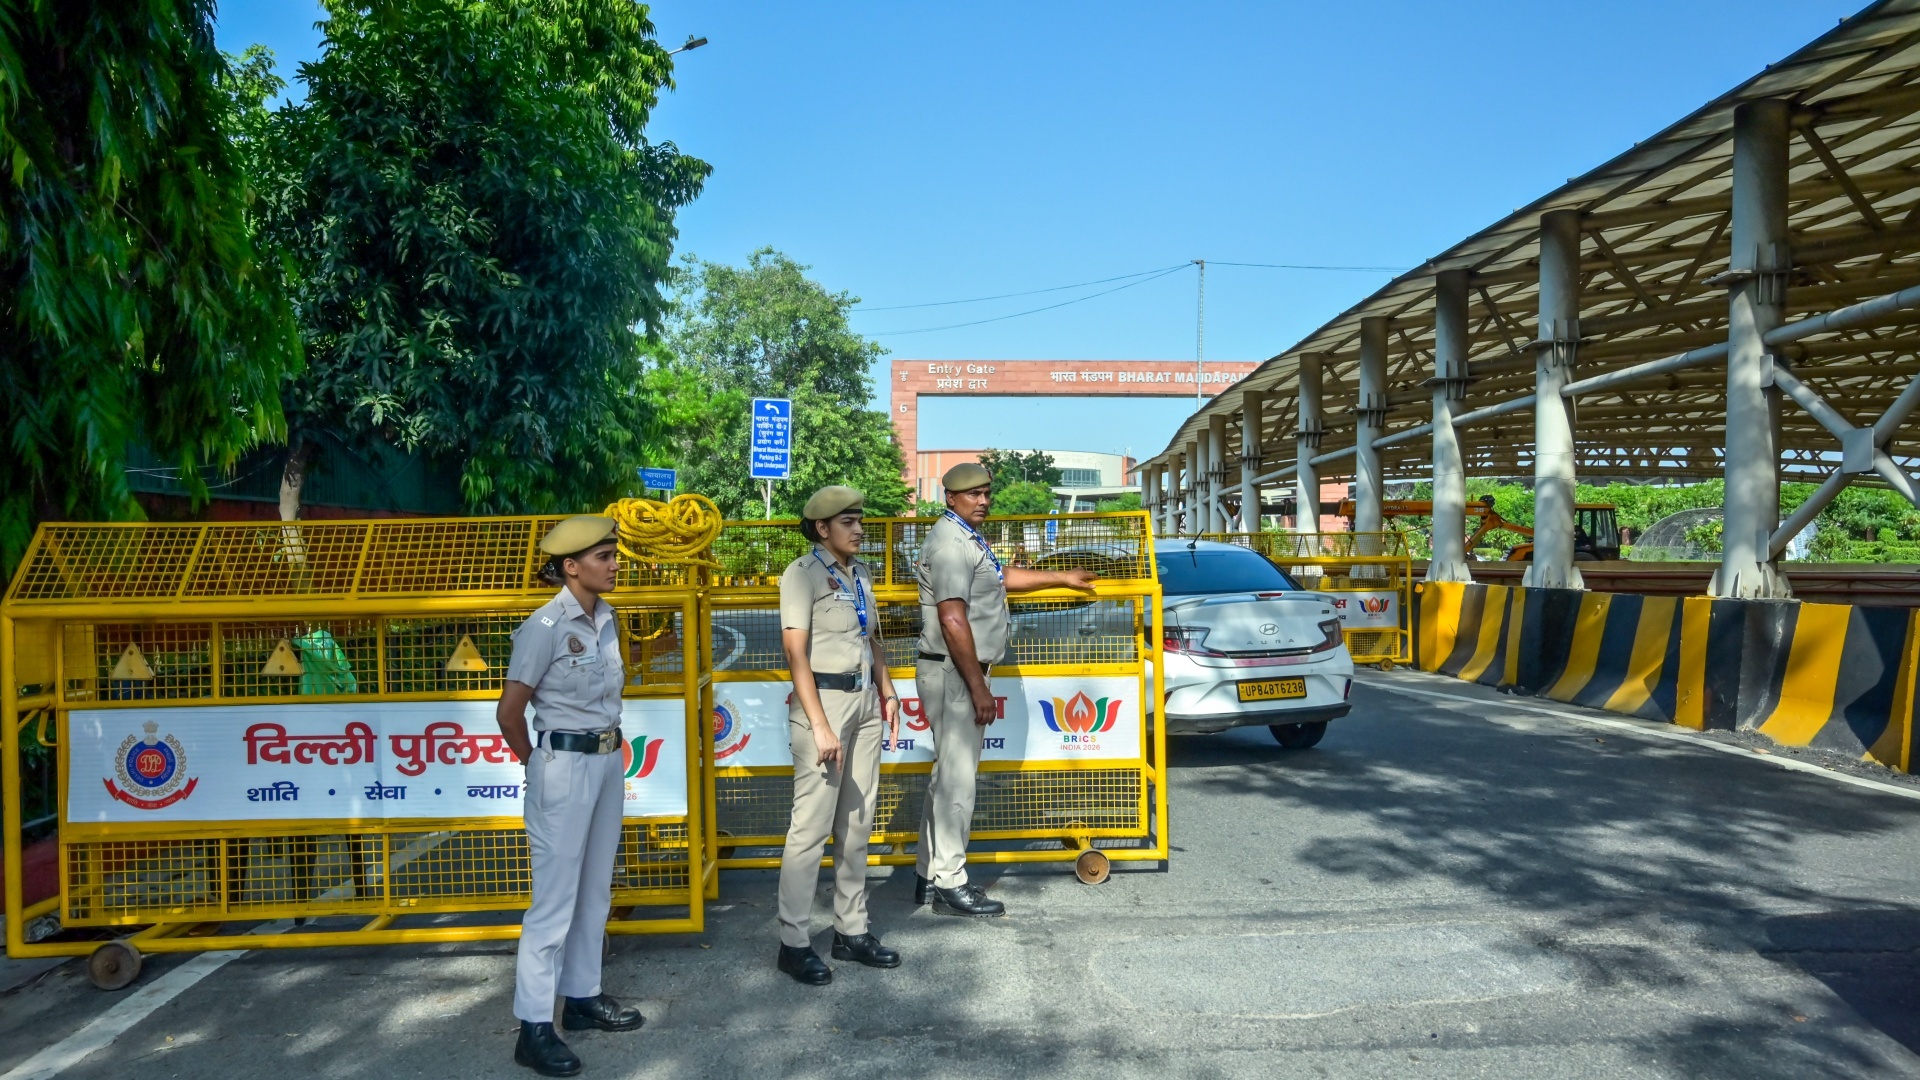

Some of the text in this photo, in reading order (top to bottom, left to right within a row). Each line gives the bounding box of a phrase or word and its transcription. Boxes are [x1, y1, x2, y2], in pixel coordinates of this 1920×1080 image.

[928, 363, 995, 376] Entry Gate
[1050, 368, 1113, 383] भारत मंडपम
[936, 375, 988, 389] प्रवेश द्वार
[1118, 371, 1172, 383] BHARAT
[899, 403, 908, 413] 6
[1245, 681, 1304, 697] UP84BT6238
[243, 721, 378, 765] दिल्ली
[247, 780, 520, 802] शांति सेवा न्याय
